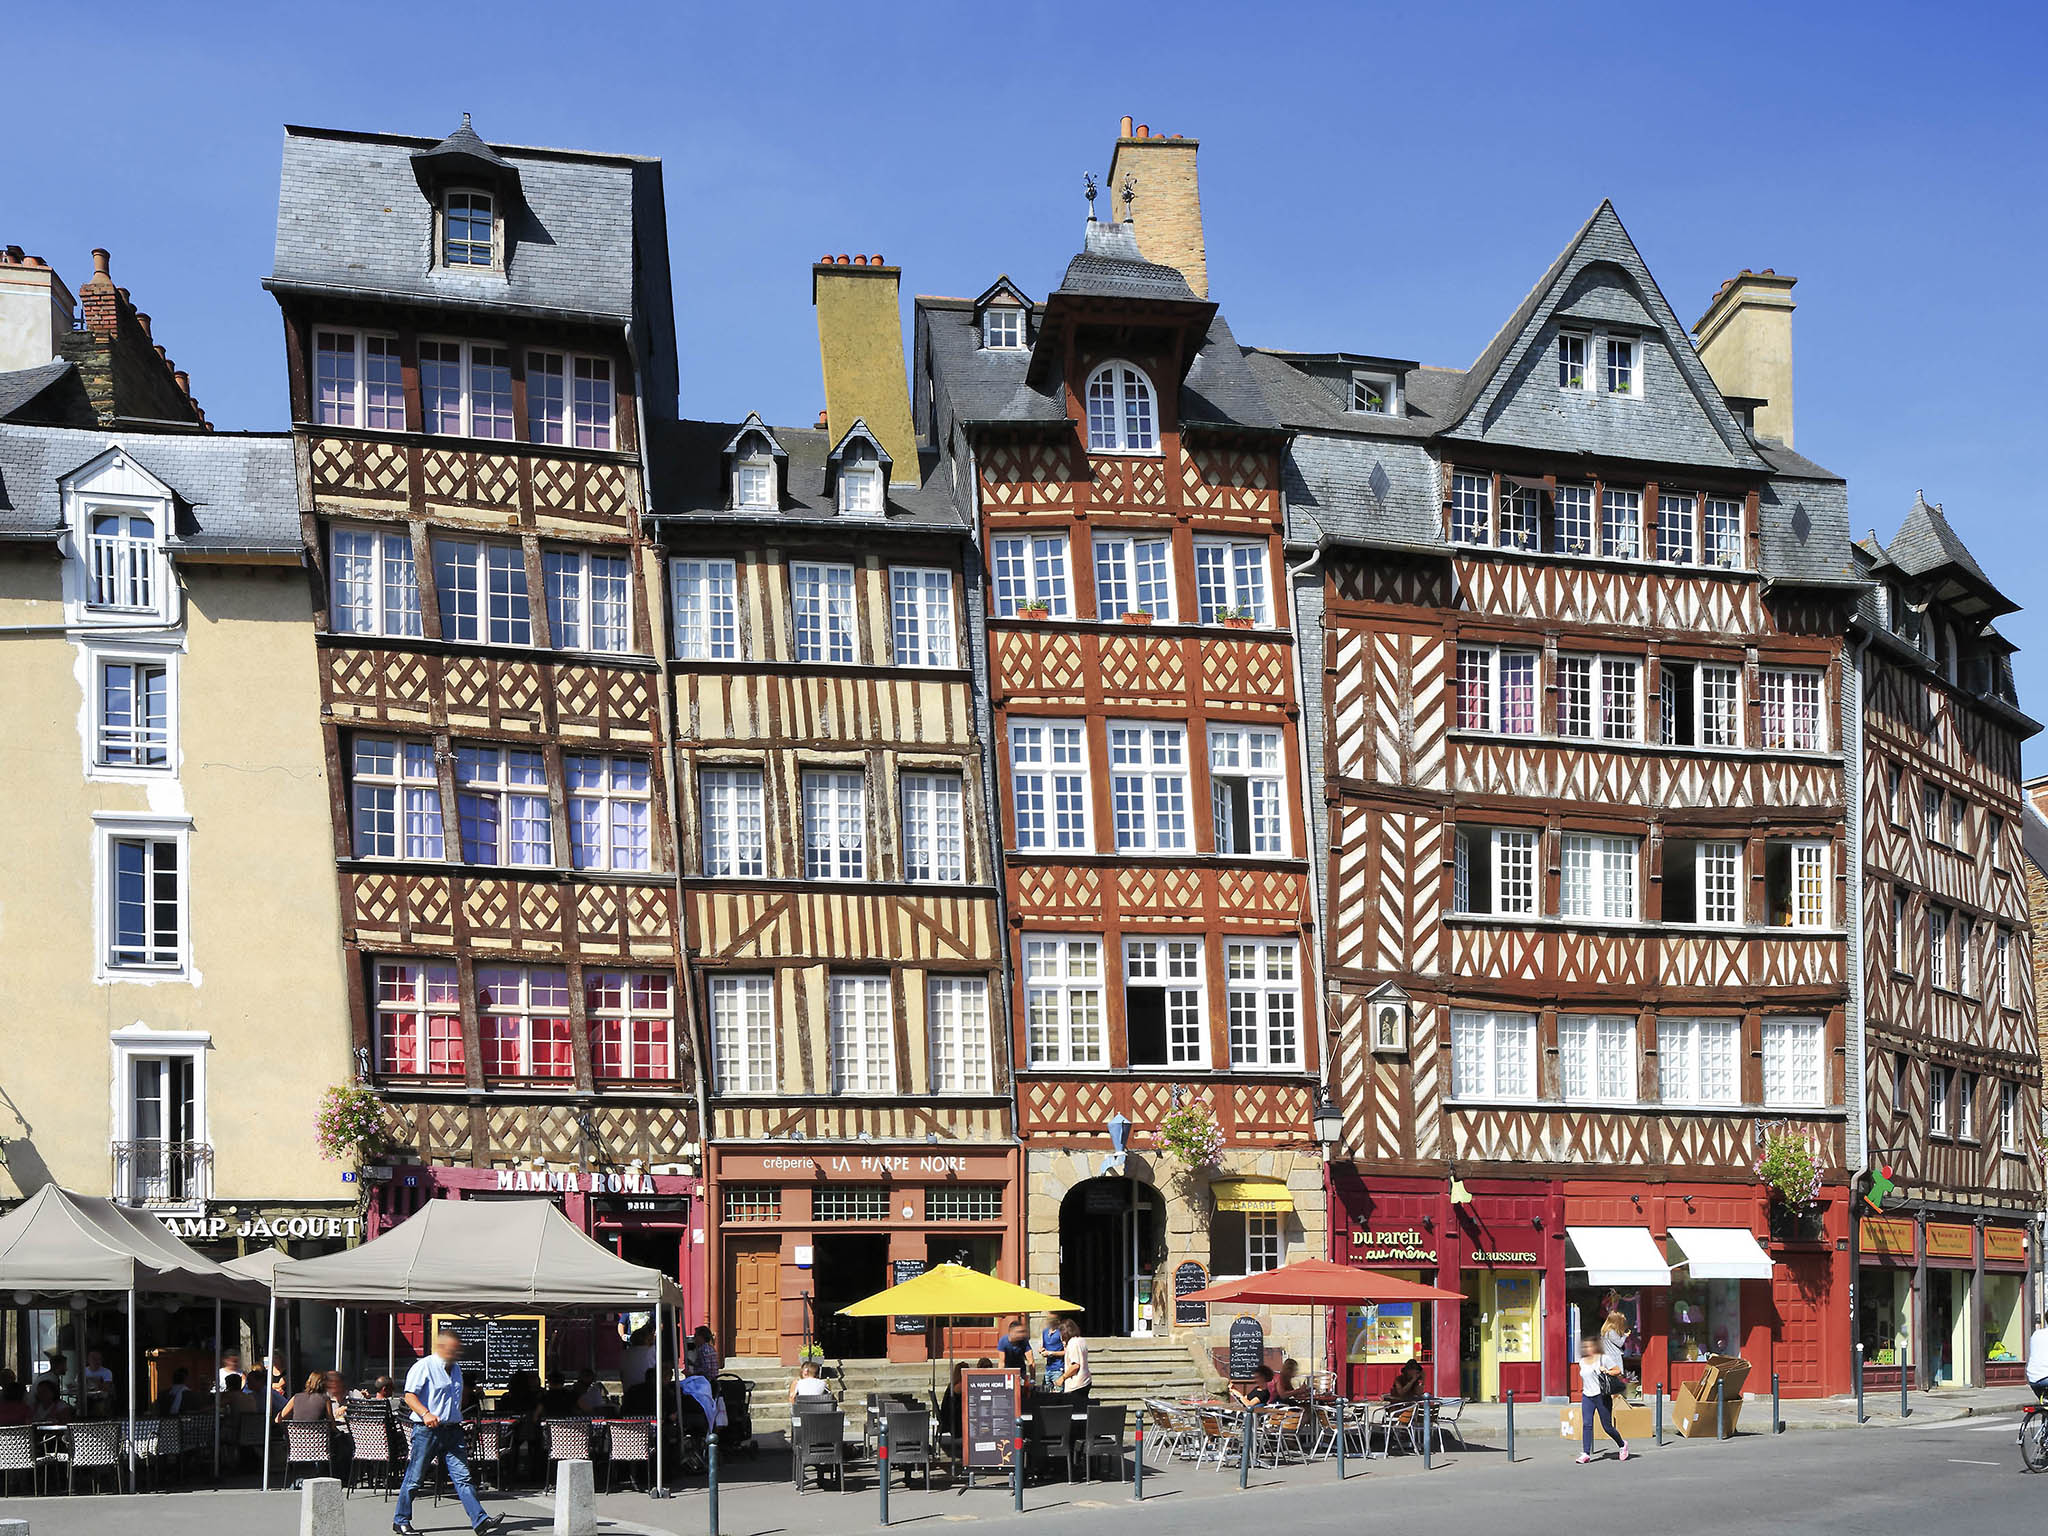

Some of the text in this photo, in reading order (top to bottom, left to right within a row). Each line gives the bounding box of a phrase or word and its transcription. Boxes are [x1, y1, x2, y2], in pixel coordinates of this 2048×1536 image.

[763, 1156, 966, 1172] crêperie LA HARPE NOIRE
[497, 1170, 655, 1194] MAMMA ROMA
[627, 1201, 655, 1211] pasta
[164, 1217, 359, 1239] AMP JACQUET
[1390, 1245, 1438, 1262] même
[1471, 1250, 1537, 1262] chaussures
